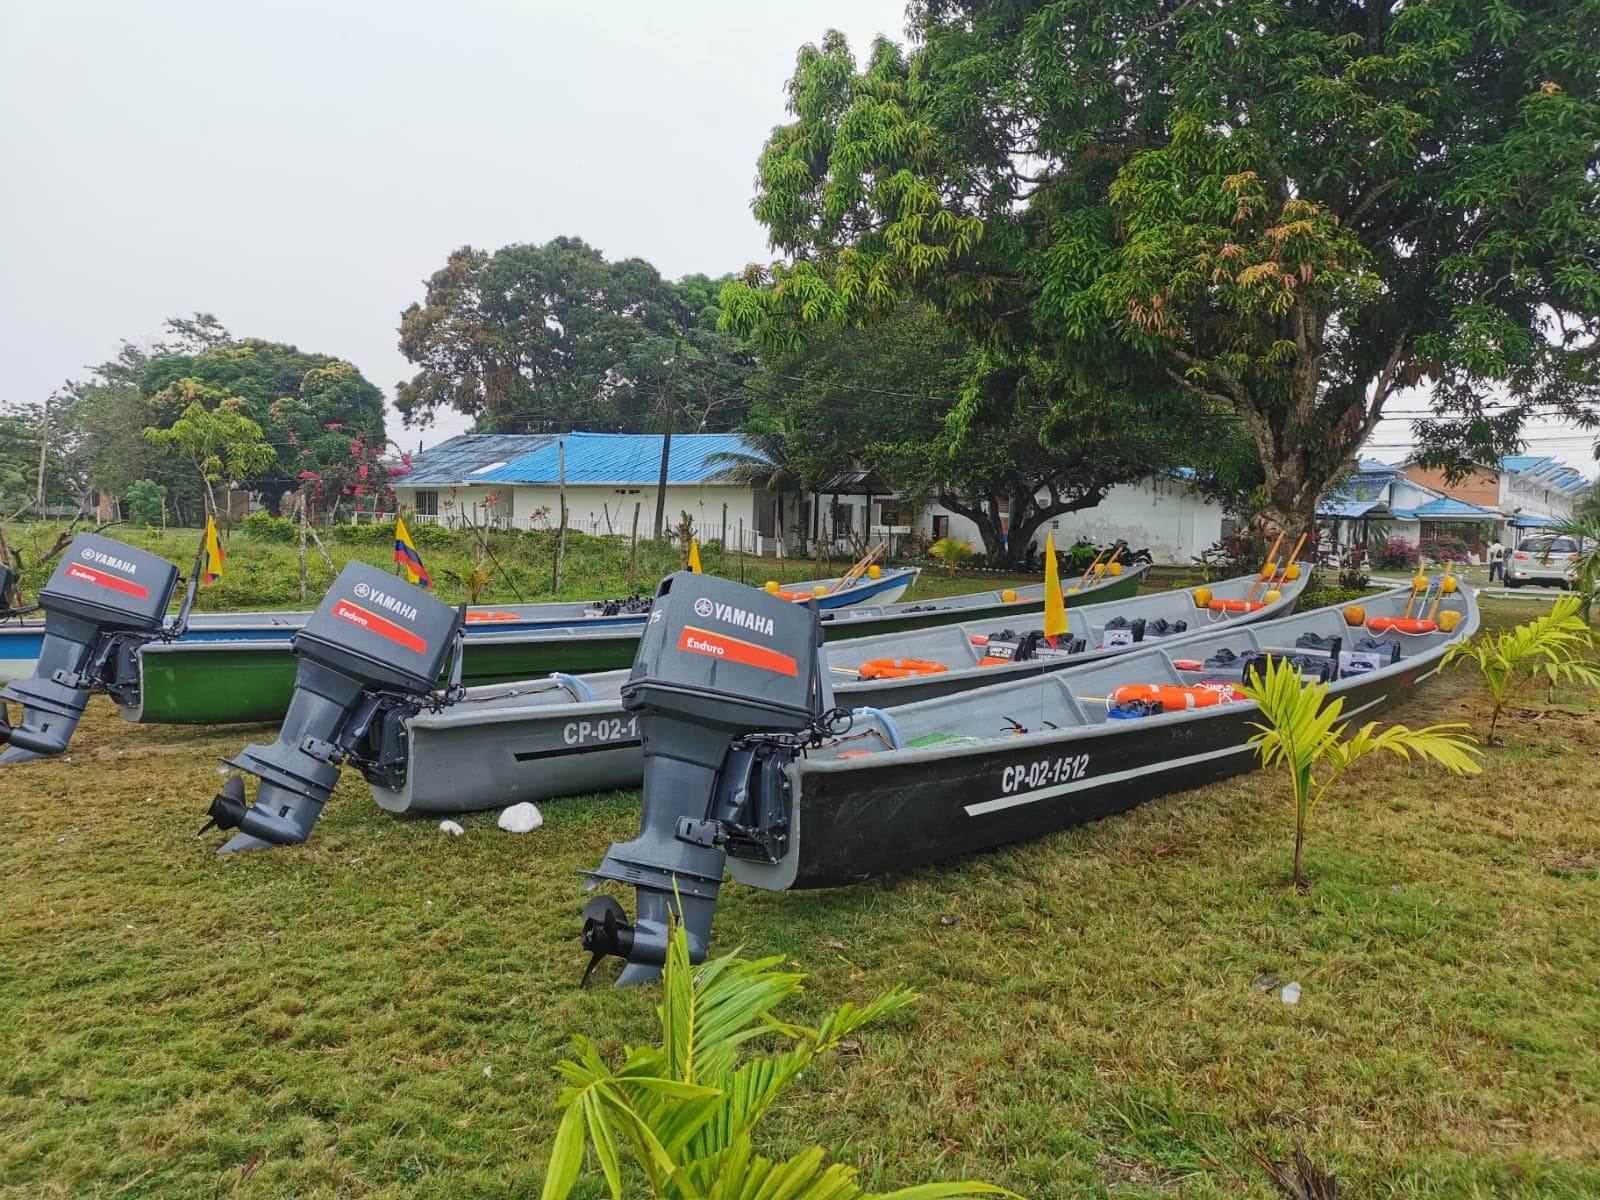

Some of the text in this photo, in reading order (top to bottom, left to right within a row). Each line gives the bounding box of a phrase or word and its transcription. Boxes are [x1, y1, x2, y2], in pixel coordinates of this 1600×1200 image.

[71, 569, 96, 582] Enduro
[94, 552, 136, 575] YAMAHA
[338, 607, 368, 626] Enduro
[369, 588, 418, 621] YAMAHA
[714, 602, 774, 636] YAMAHA
[686, 637, 725, 655] Enduro
[564, 716, 640, 744] CP-02-1
[1002, 754, 1089, 793] CP-02-1512
